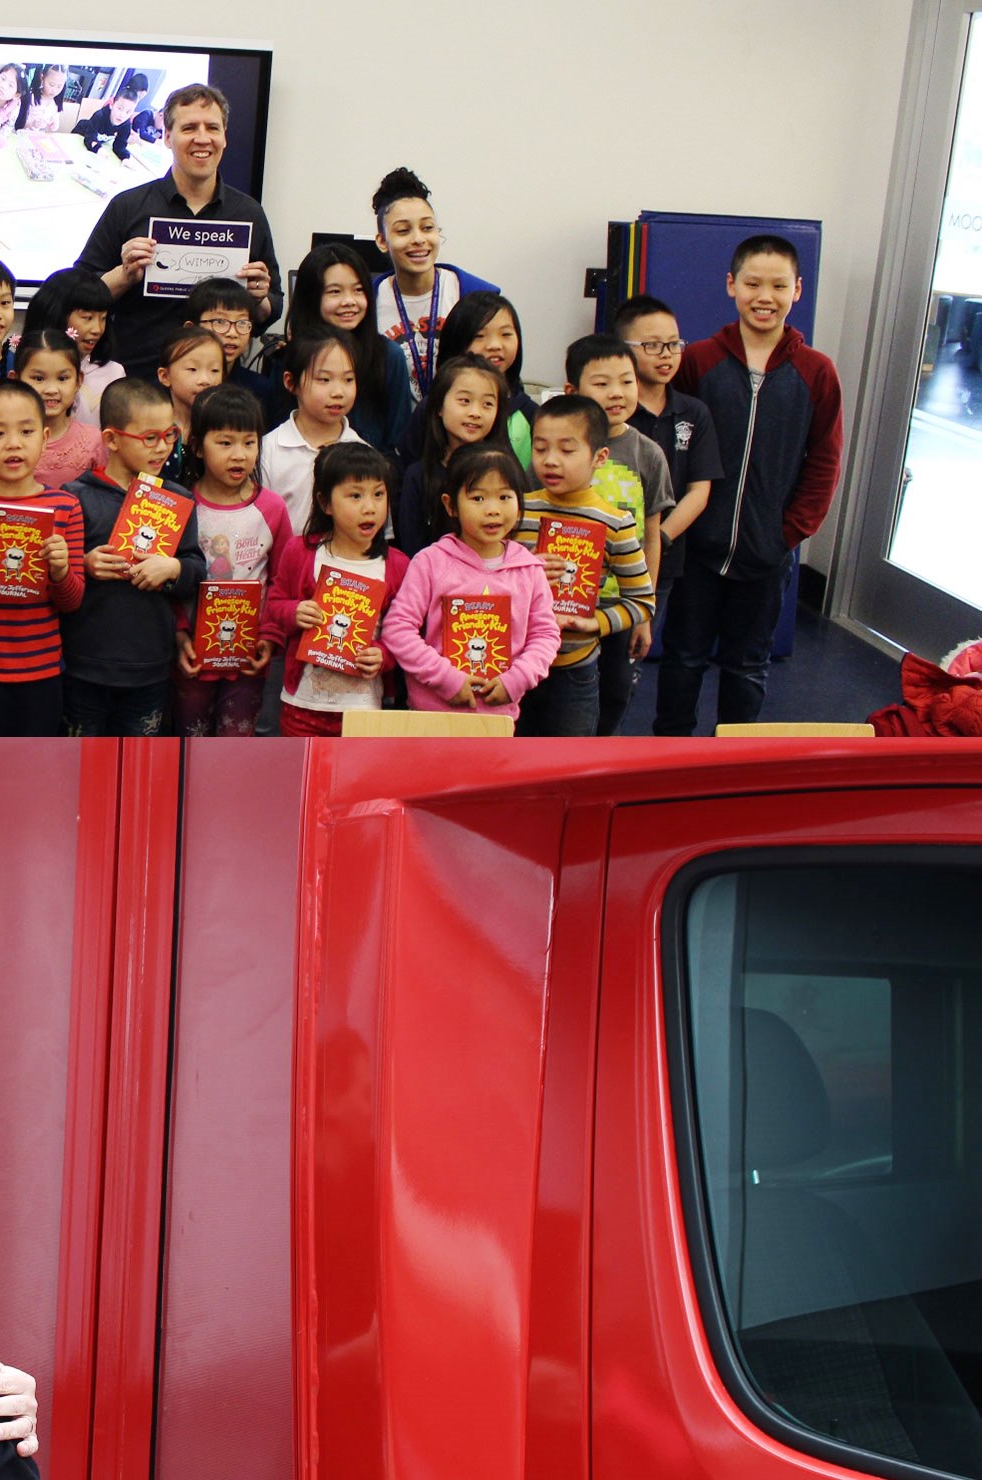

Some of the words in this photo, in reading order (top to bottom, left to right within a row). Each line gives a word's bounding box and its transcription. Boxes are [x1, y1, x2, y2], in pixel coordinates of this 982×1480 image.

[168, 226, 190, 240] We
[194, 229, 234, 245] speak
[184, 258, 224, 268] WIMPY!
[140, 499, 178, 521] Awesome
[130, 504, 166, 524] Friendly
[164, 516, 182, 533] Kid
[0, 523, 42, 537] Awesome
[556, 535, 594, 548] Awesome
[547, 544, 583, 556] Friendly
[582, 546, 600, 560] Kid
[332, 586, 372, 605] Awesome
[214, 598, 251, 608] Awesome
[322, 592, 358, 613] Friendly
[356, 602, 376, 618] Kid
[206, 604, 241, 618] Friendly
[240, 604, 256, 616] Kid
[460, 612, 500, 622] Awesome
[452, 618, 490, 633] Friendly
[488, 620, 508, 632] Kid
[316, 657, 346, 671] JOURNAL
